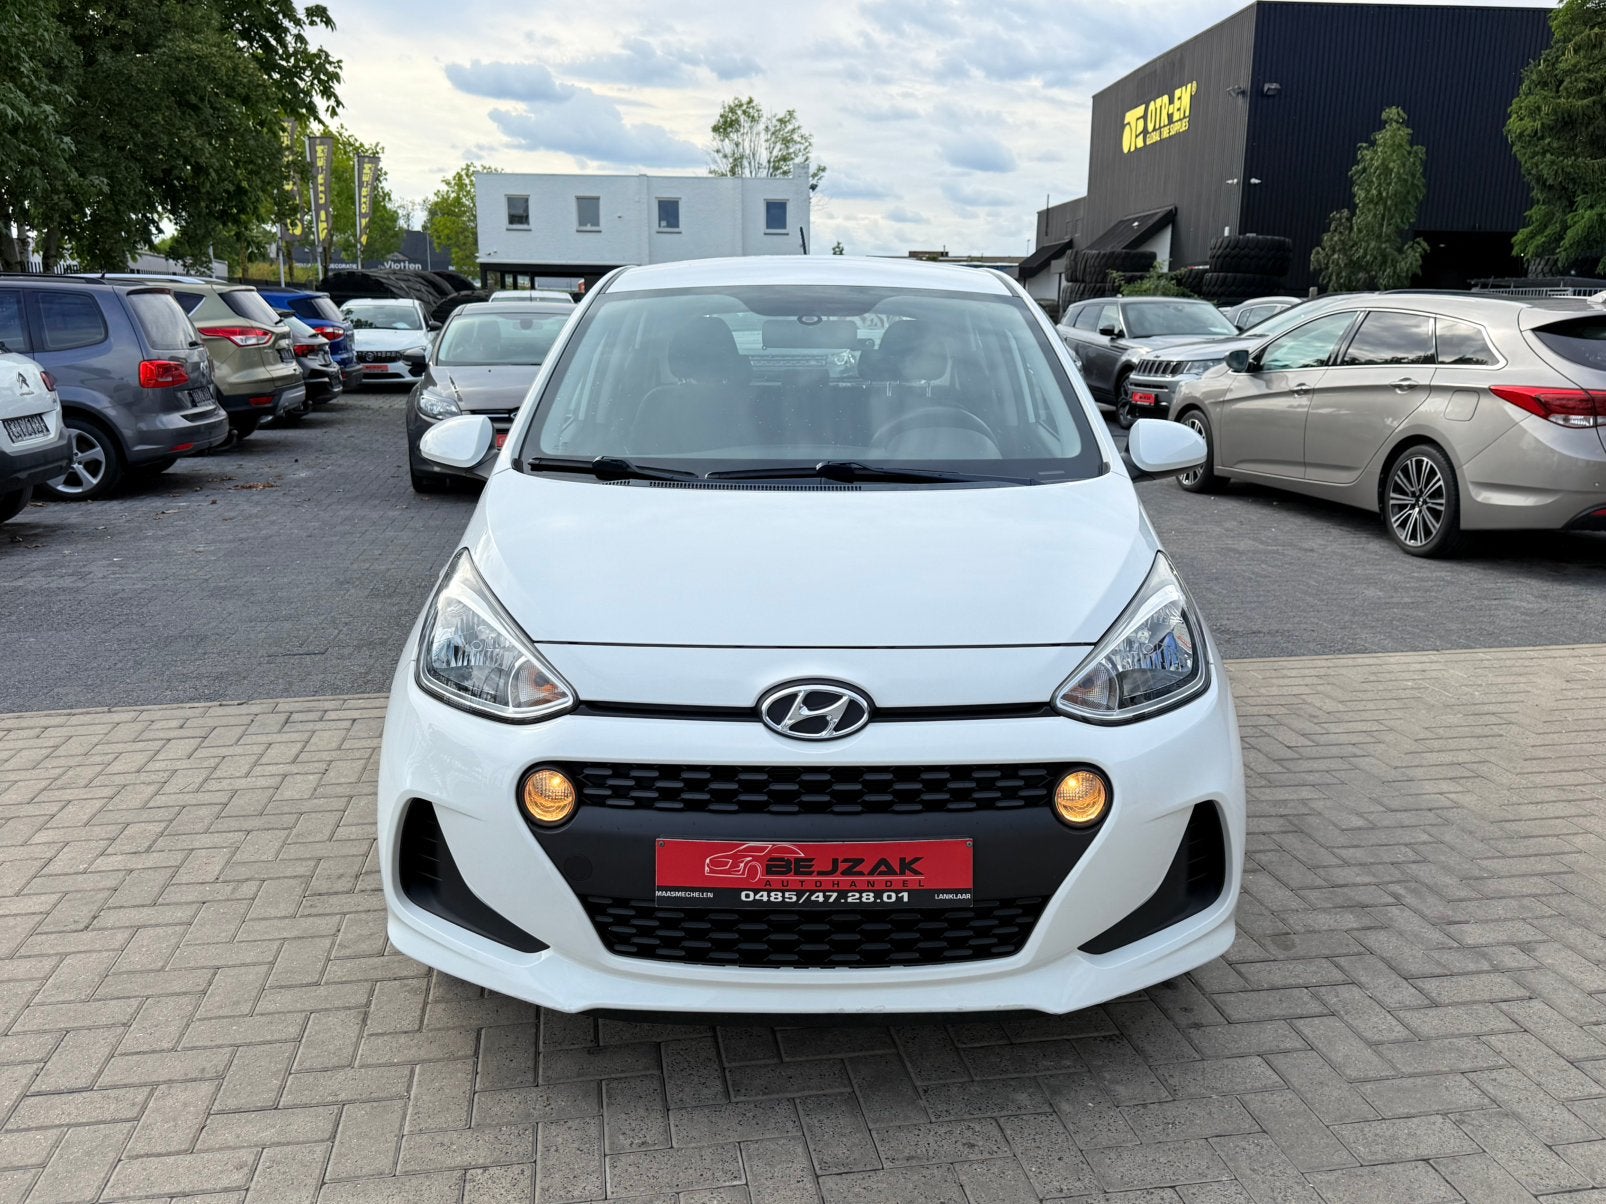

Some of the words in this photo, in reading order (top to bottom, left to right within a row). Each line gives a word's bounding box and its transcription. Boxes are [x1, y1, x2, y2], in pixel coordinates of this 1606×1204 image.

[765, 857, 924, 876] BEJZAK
[764, 879, 925, 888] AUTOHANDEL
[655, 890, 714, 898] MAASMECHELEN
[740, 890, 909, 904] 0485/47.28.01
